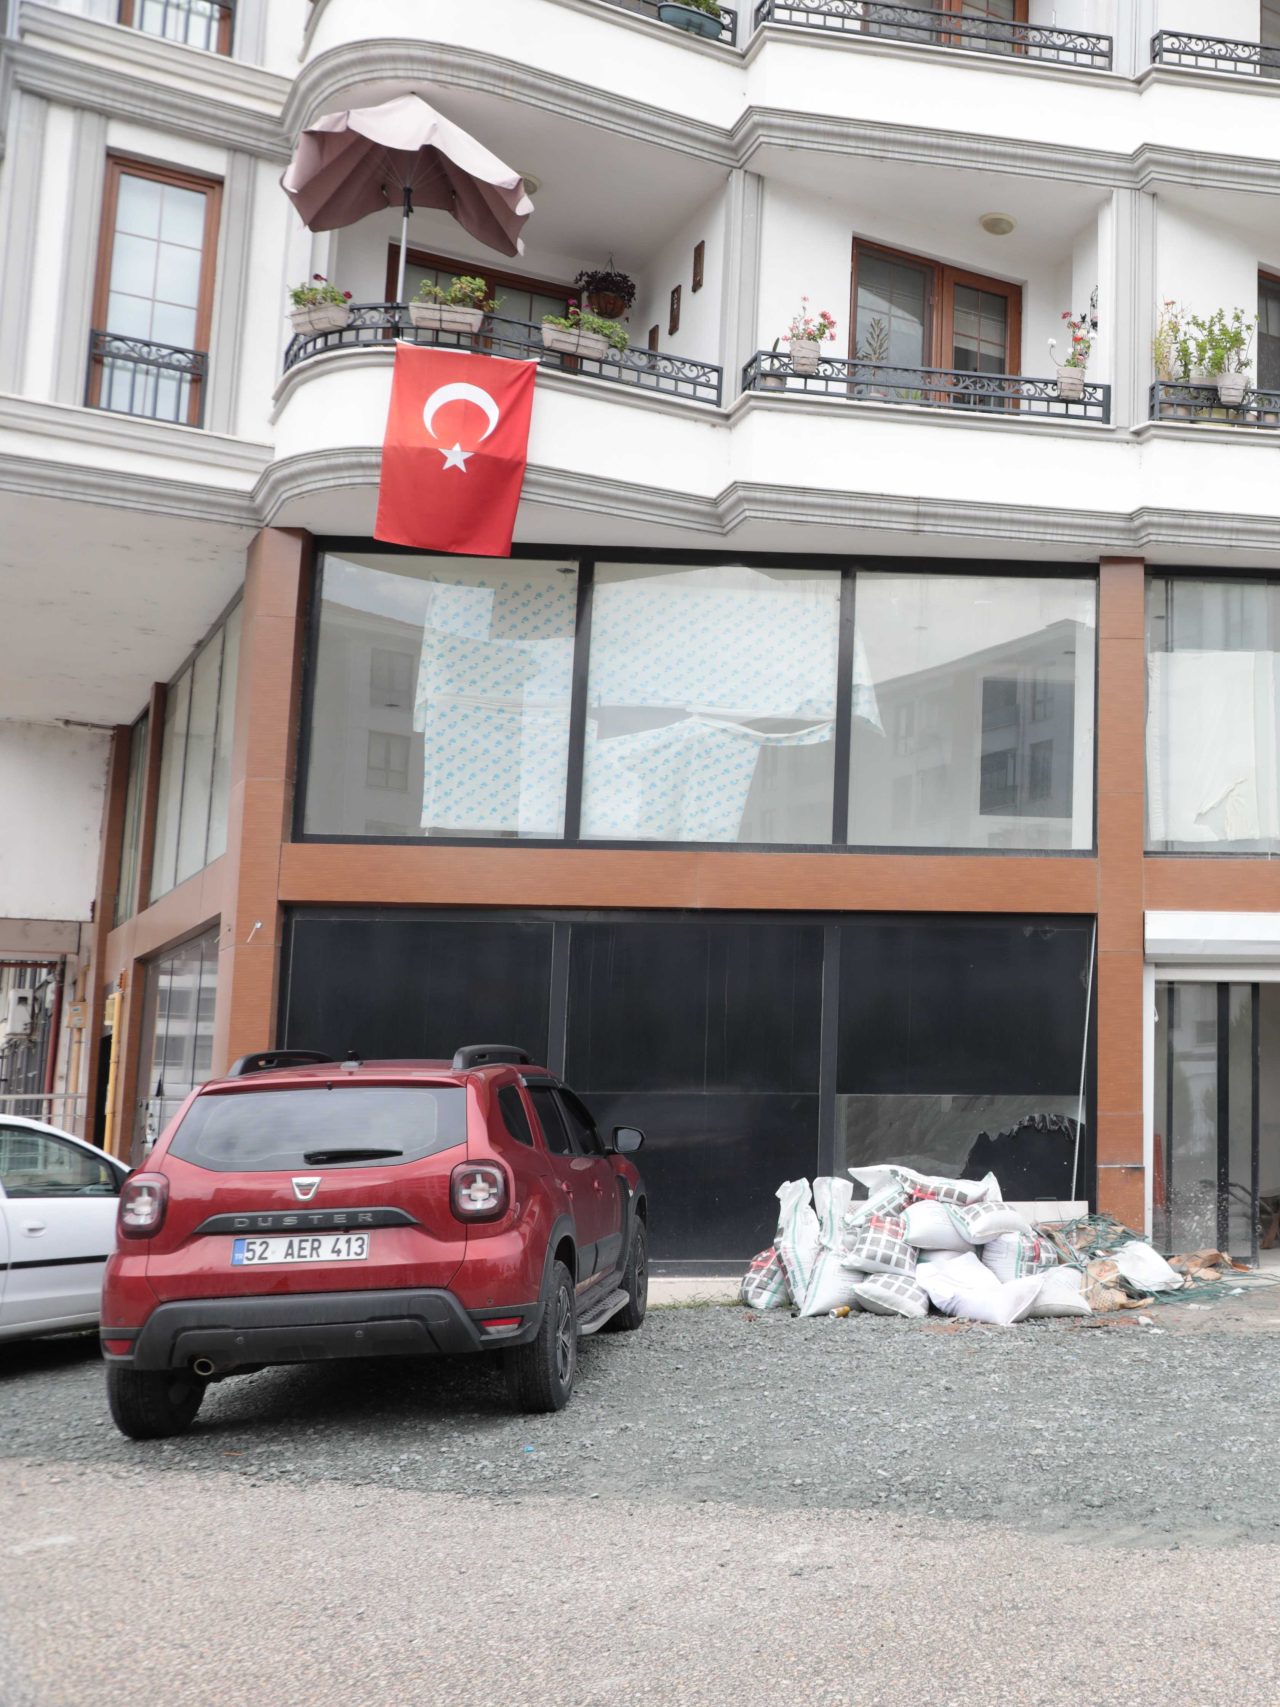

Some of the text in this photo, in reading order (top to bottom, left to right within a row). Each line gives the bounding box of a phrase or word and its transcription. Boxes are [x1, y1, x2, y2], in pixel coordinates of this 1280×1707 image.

[233, 1213, 373, 1228] DUSTER
[245, 1240, 270, 1261] 52
[284, 1238, 321, 1259] AER
[331, 1236, 365, 1257] 413
